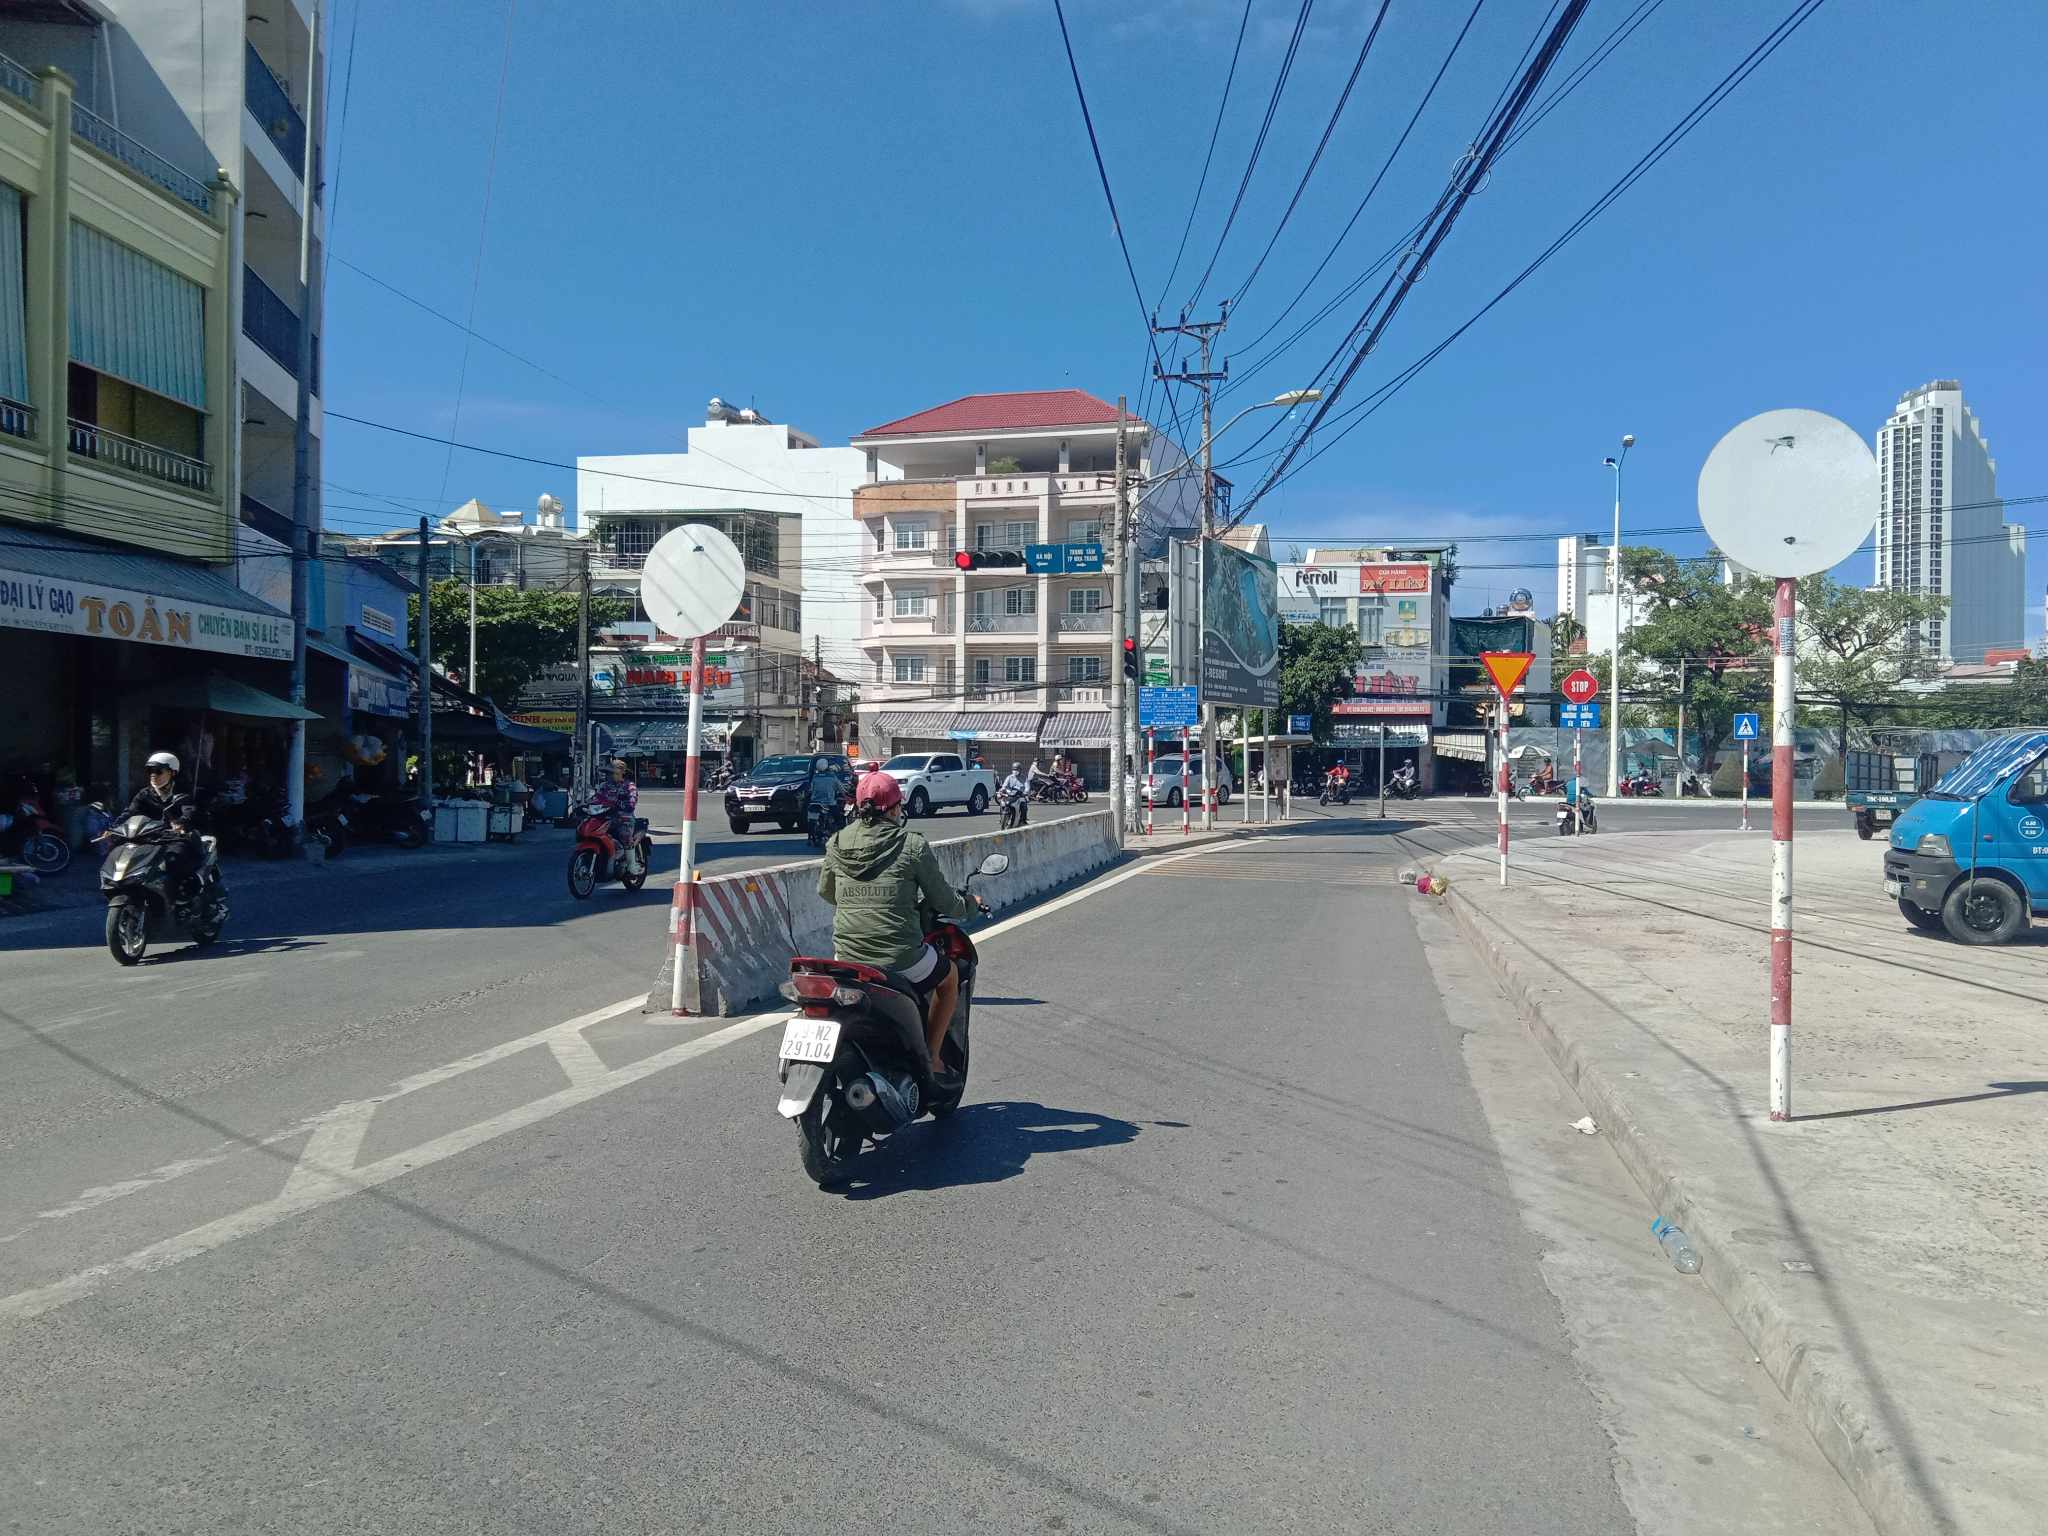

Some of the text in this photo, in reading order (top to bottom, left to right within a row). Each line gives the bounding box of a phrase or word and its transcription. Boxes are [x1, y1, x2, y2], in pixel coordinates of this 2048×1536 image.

[28, 579, 44, 610] LÝ
[49, 588, 75, 618] GẠO
[1571, 681, 1589, 693] STOP
[842, 886, 896, 897] ABSOLUTE
[784, 1040, 832, 1060] 291.04
